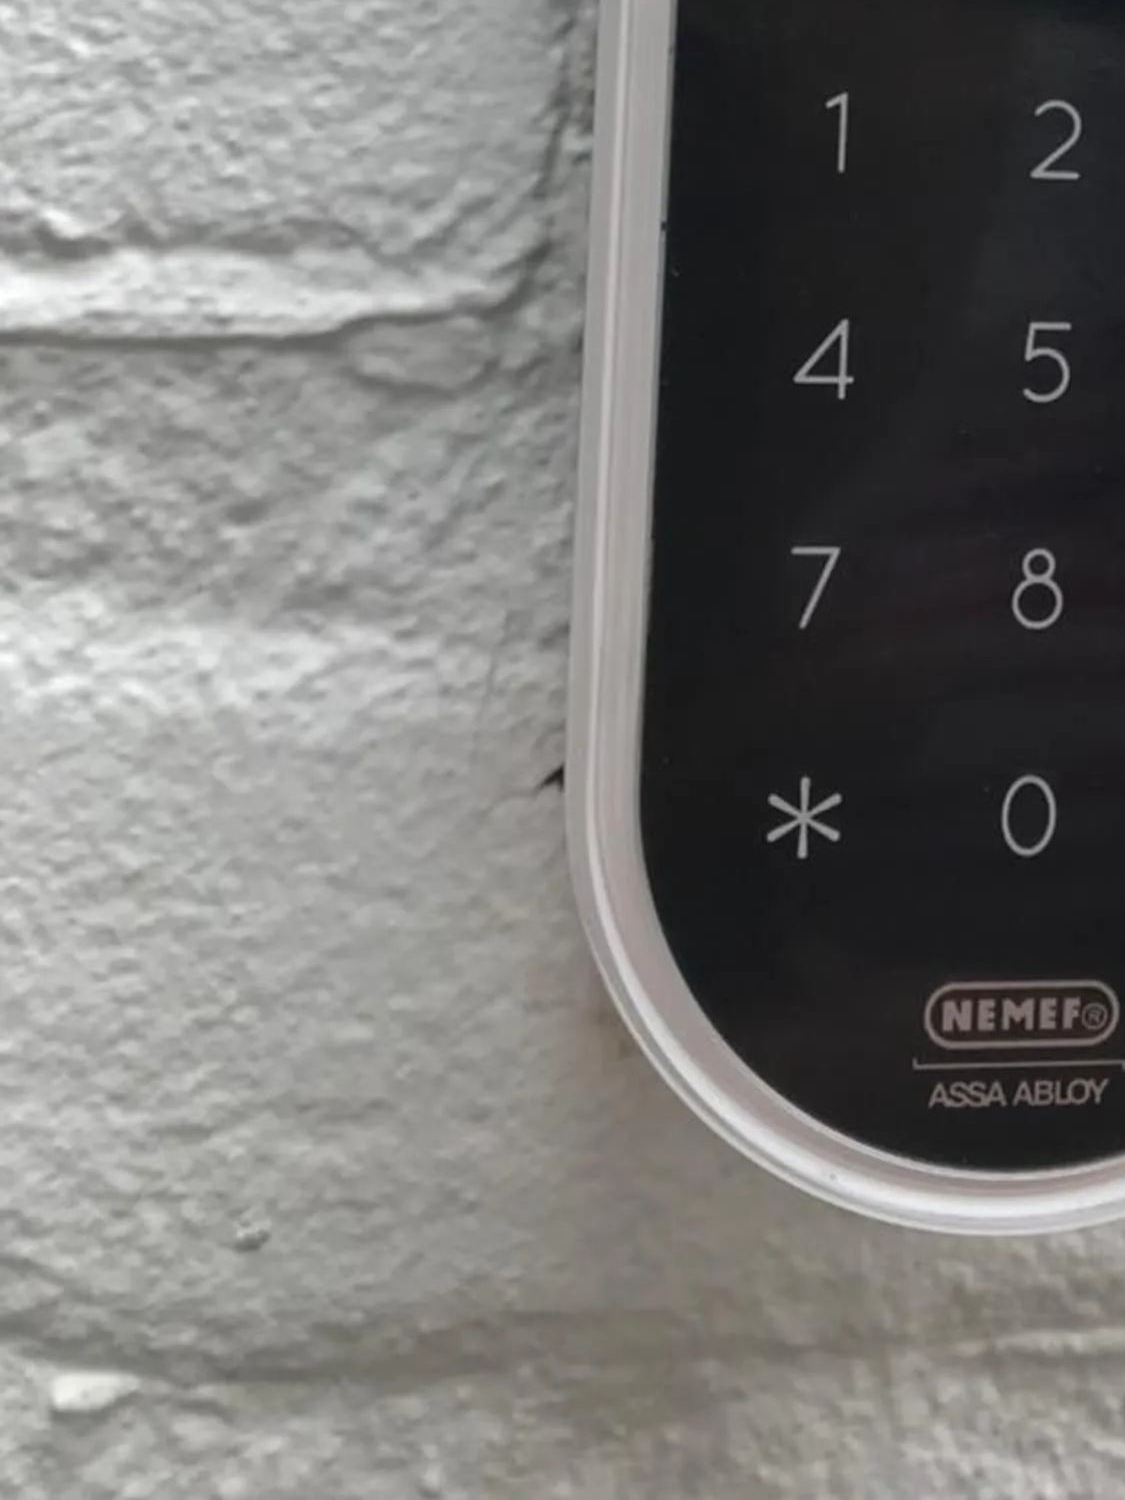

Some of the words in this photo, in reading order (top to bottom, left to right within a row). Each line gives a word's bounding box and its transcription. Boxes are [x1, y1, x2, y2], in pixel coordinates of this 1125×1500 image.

[825, 92, 849, 173] 1
[1030, 100, 1082, 180] 2
[793, 318, 855, 400] 4
[1022, 322, 1072, 403] 5
[791, 546, 842, 629] 7
[1012, 548, 1063, 630] 8
[1001, 774, 1057, 857] 0
[927, 1080, 1008, 1109] ASSA
[1011, 1077, 1111, 1106] ABLOY
